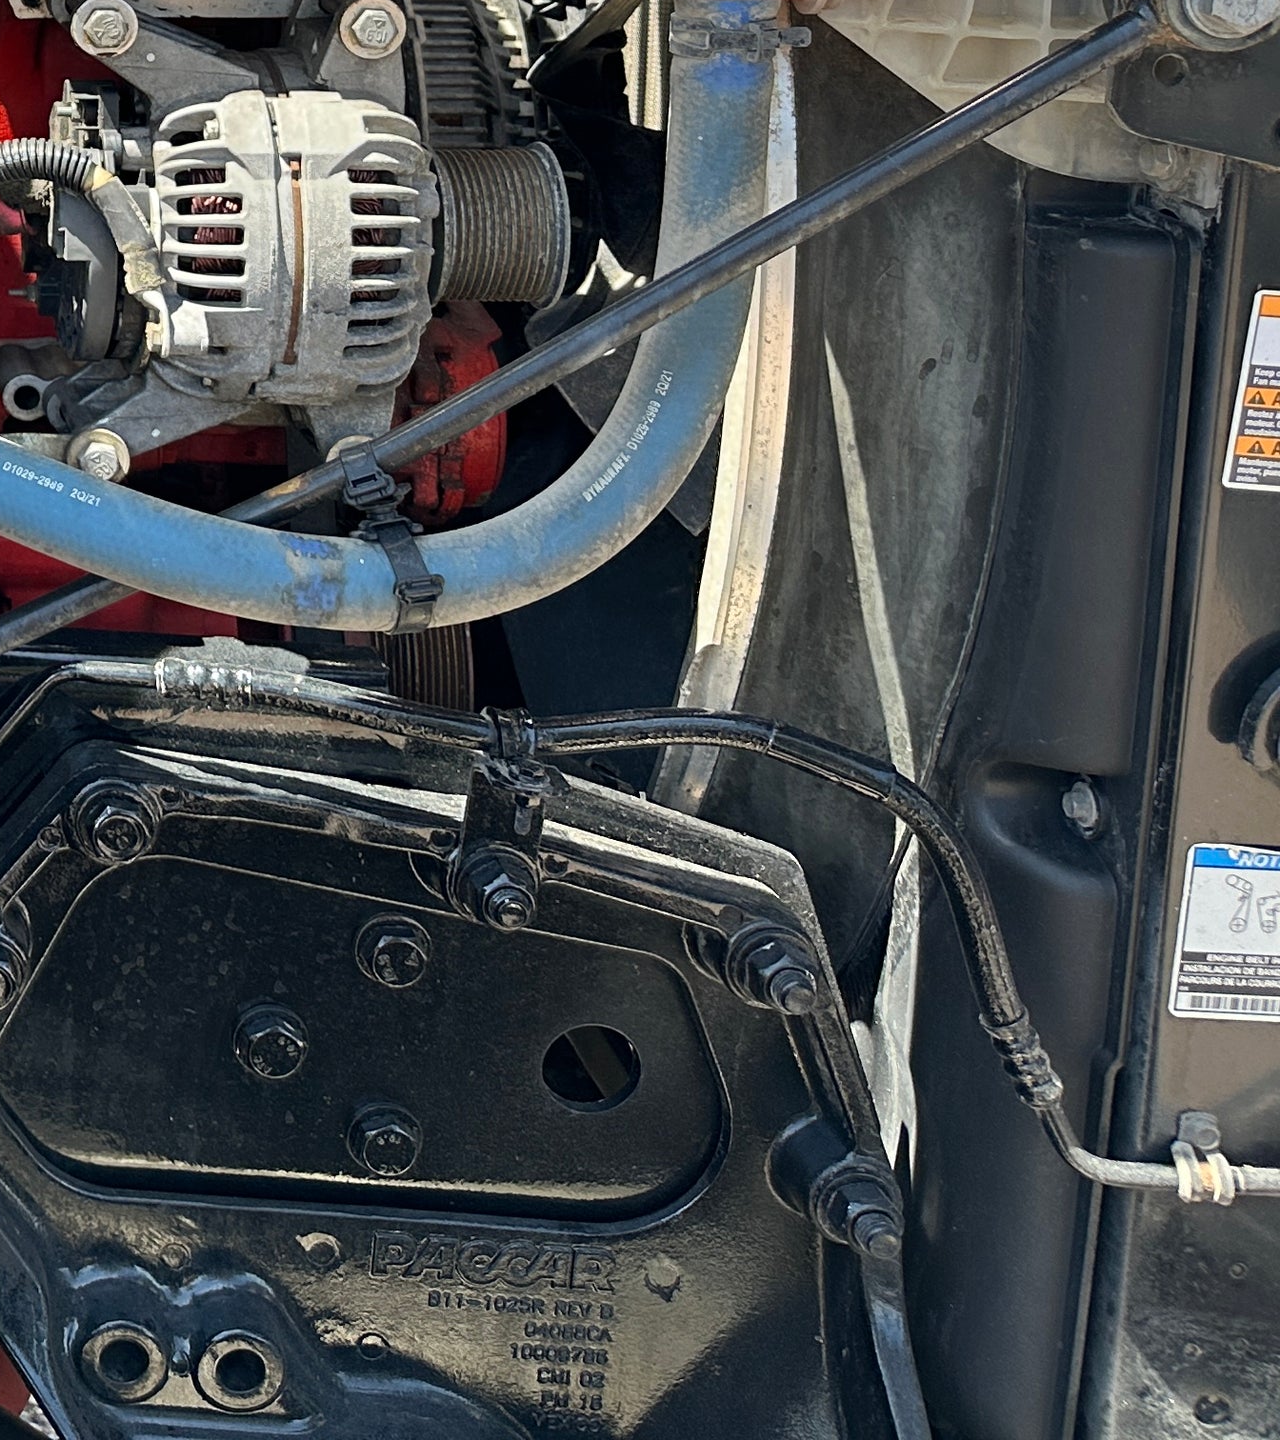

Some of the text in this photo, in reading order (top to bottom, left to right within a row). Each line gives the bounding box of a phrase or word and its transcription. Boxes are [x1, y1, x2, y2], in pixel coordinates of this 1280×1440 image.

[1252, 376, 1269, 386] Fan
[1254, 367, 1276, 378] Keep
[626, 400, 660, 450] D1029-2989
[655, 370, 673, 396] 2Q/21
[2, 461, 64, 492] D1029-2989
[69, 488, 102, 507] 2Q/21
[1206, 954, 1270, 964] ENGINE BELT
[369, 1230, 616, 1294] PACCAR
[554, 1300, 592, 1319] REV
[580, 1370, 606, 1389] 02
